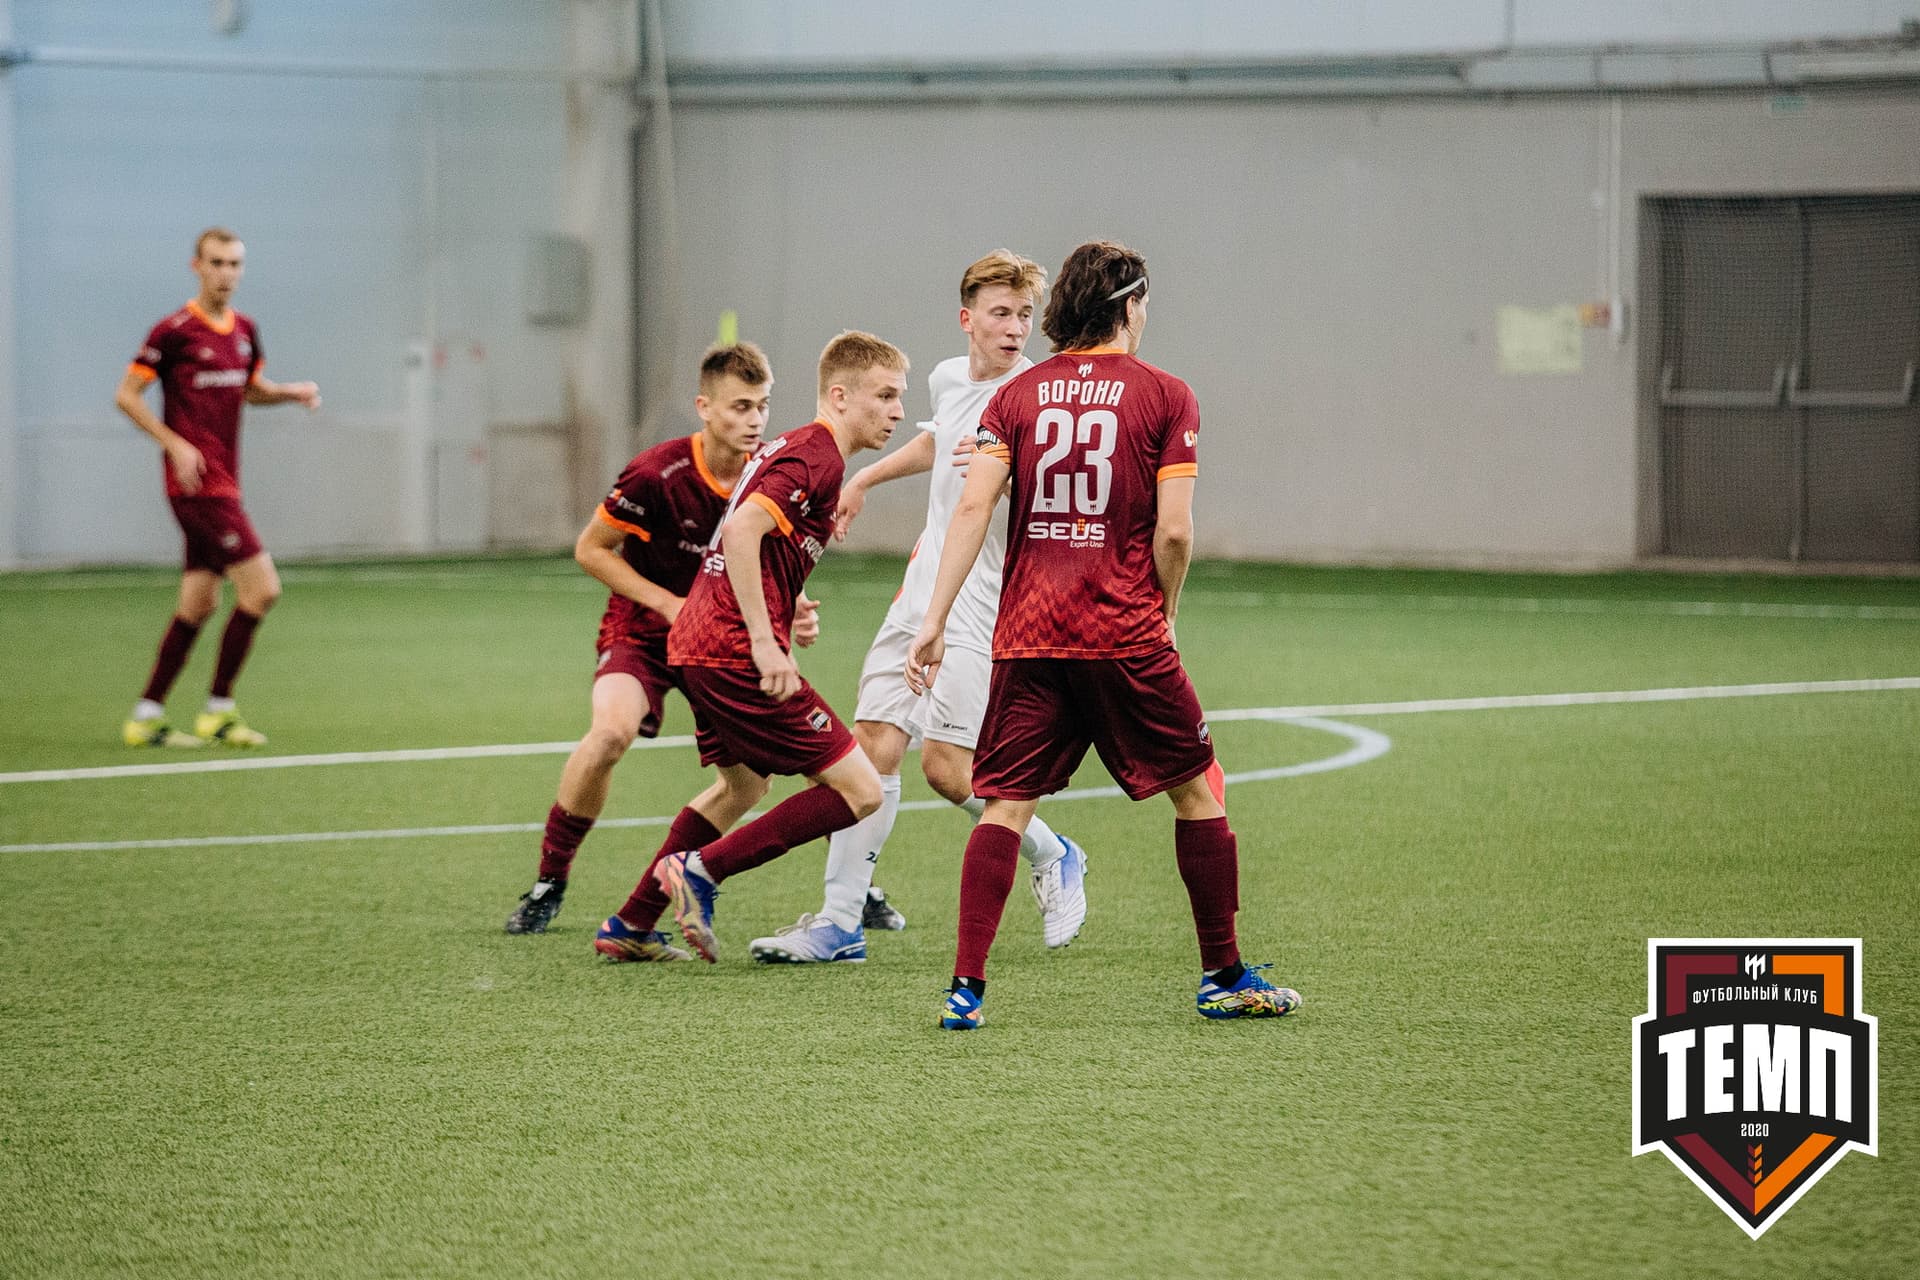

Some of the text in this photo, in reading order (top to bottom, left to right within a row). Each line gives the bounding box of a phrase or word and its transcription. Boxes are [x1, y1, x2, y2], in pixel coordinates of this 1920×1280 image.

[1038, 379, 1125, 407] ВОРОНА
[1031, 408, 1118, 516] 23
[1028, 520, 1106, 541] SEUS
